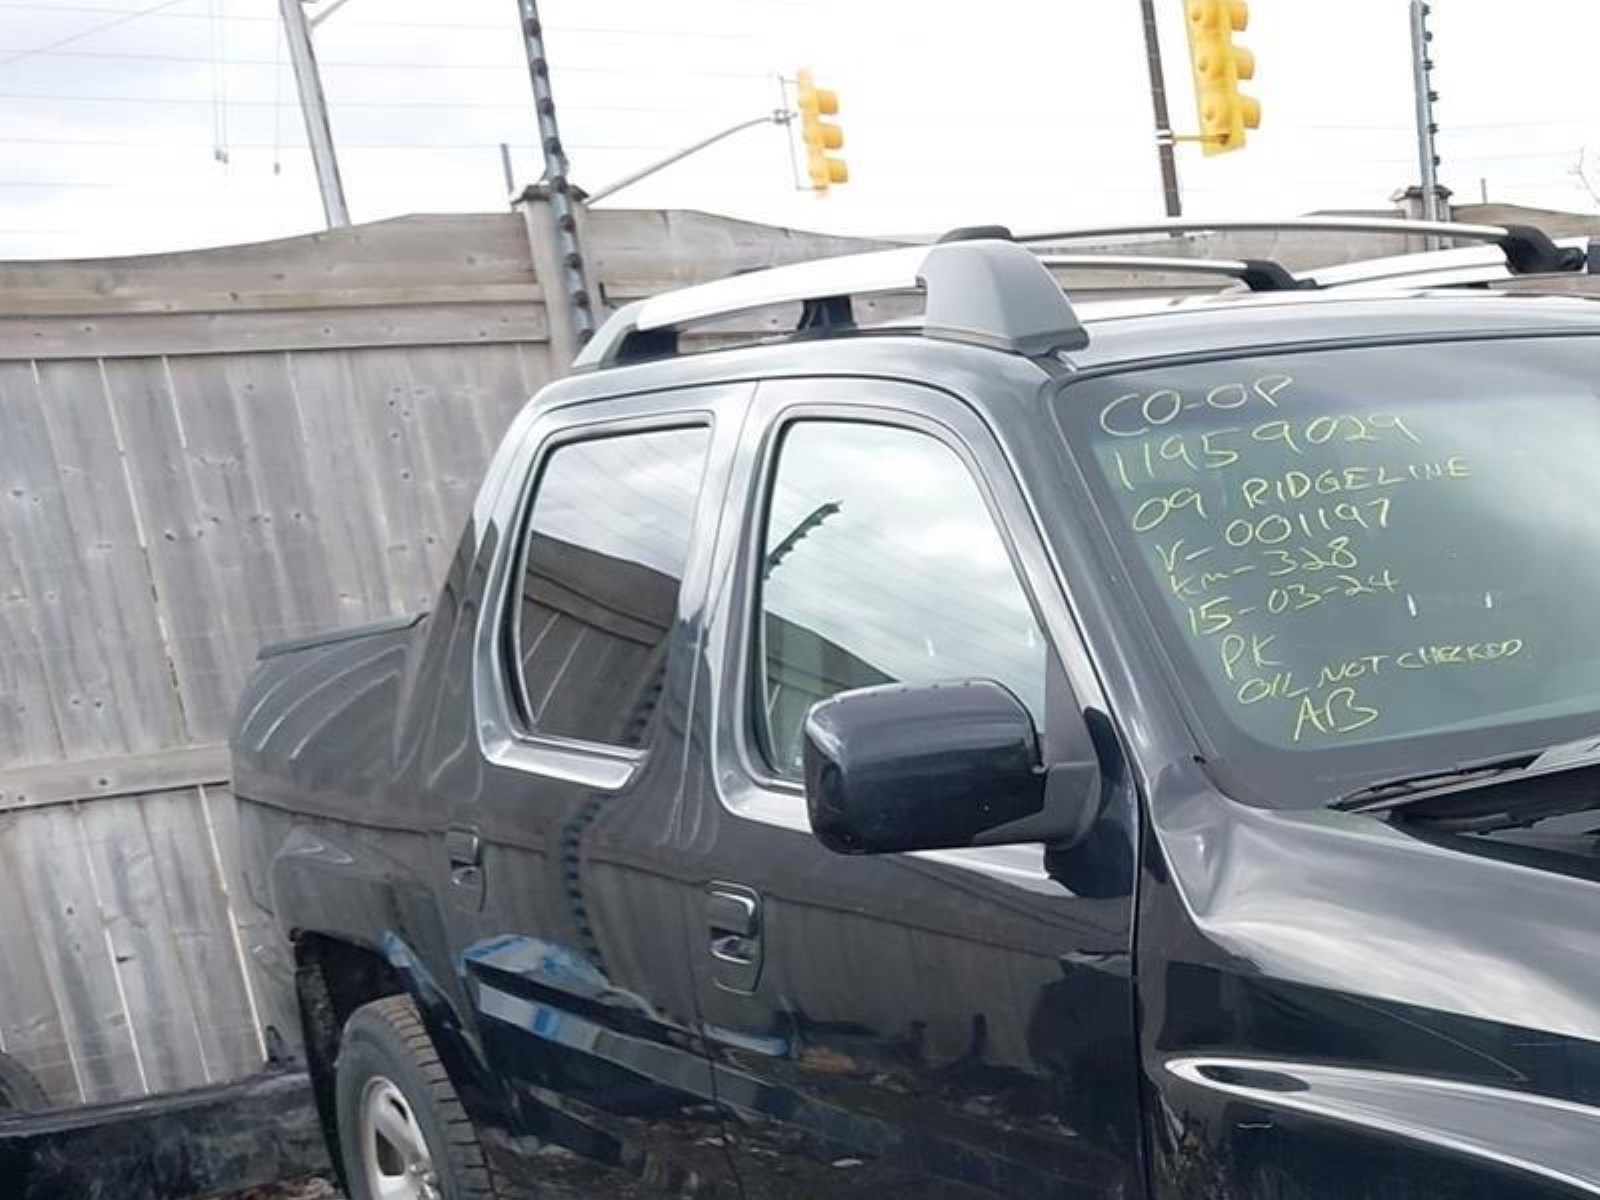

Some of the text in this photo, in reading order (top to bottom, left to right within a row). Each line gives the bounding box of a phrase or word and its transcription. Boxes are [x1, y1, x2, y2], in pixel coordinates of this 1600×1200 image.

[1100, 375, 1293, 436] CO-OP
[1115, 412, 1422, 490] 11959029
[1133, 456, 1473, 532] 09 RIDGELINE
[1221, 634, 1283, 680] PK
[1317, 654, 1390, 689] NOT
[1397, 639, 1523, 668] CHECKED
[1294, 687, 1379, 741] AB
